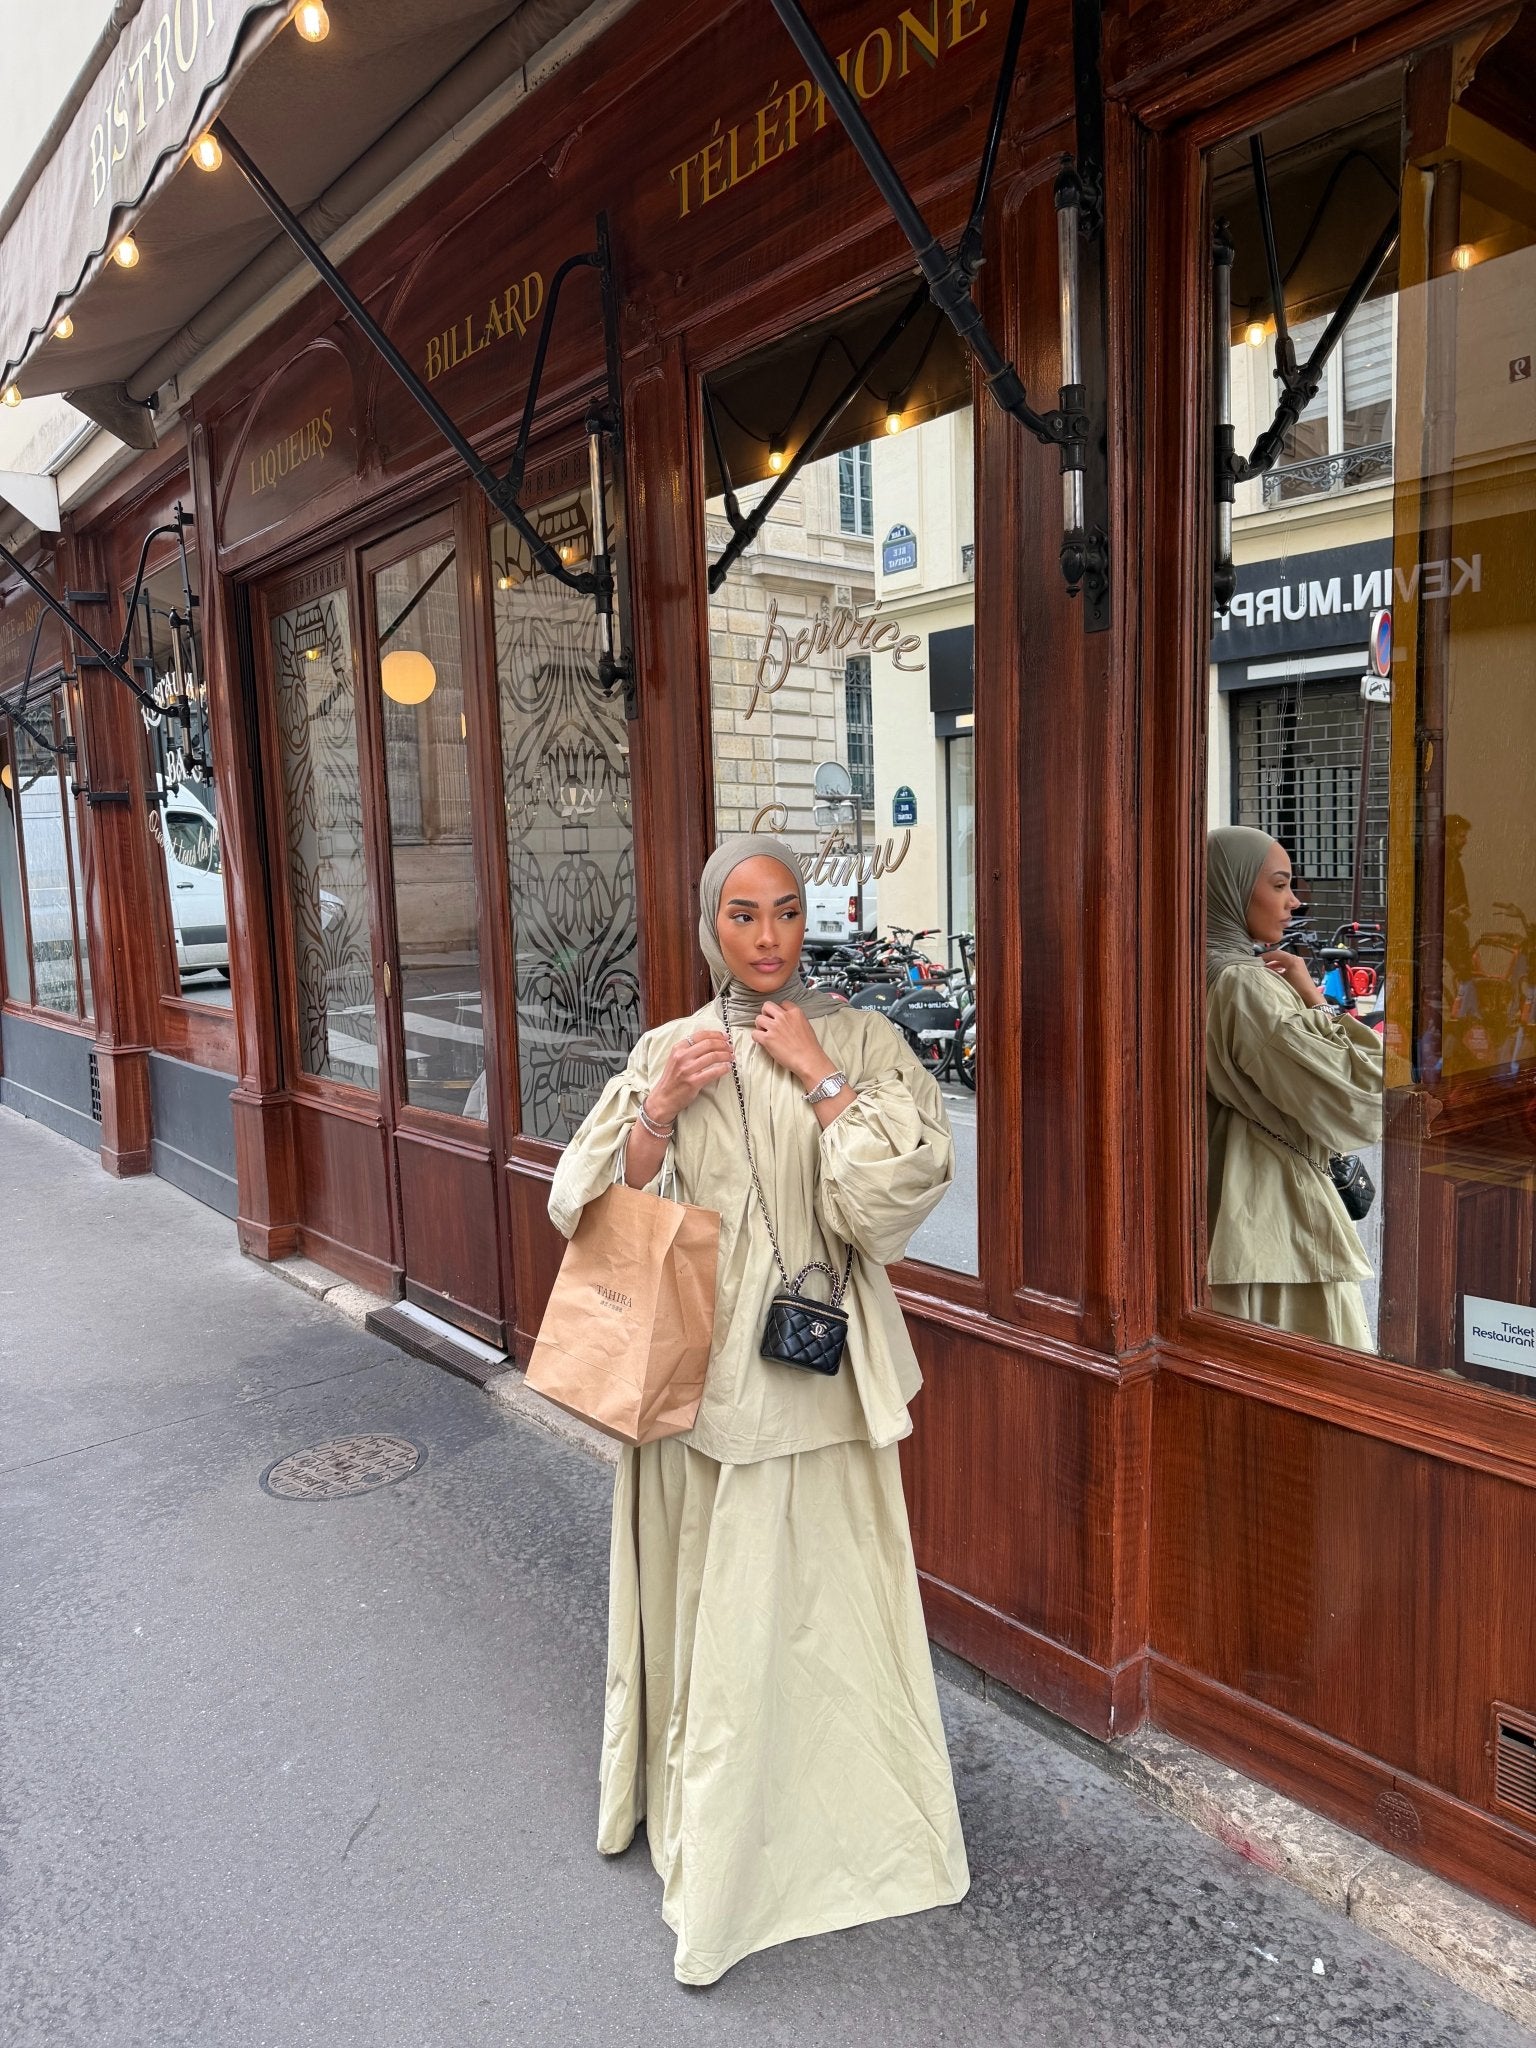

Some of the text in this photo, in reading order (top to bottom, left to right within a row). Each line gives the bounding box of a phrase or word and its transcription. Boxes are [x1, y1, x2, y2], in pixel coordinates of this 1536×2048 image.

[424, 271, 544, 382] BILLARD
[251, 407, 332, 495] LIQUEURS
[744, 597, 926, 720] Service
[596, 1284, 632, 1308] TAHIRA
[1472, 1326, 1535, 1348] Restaurant
[1500, 1321, 1535, 1338] Ticket
